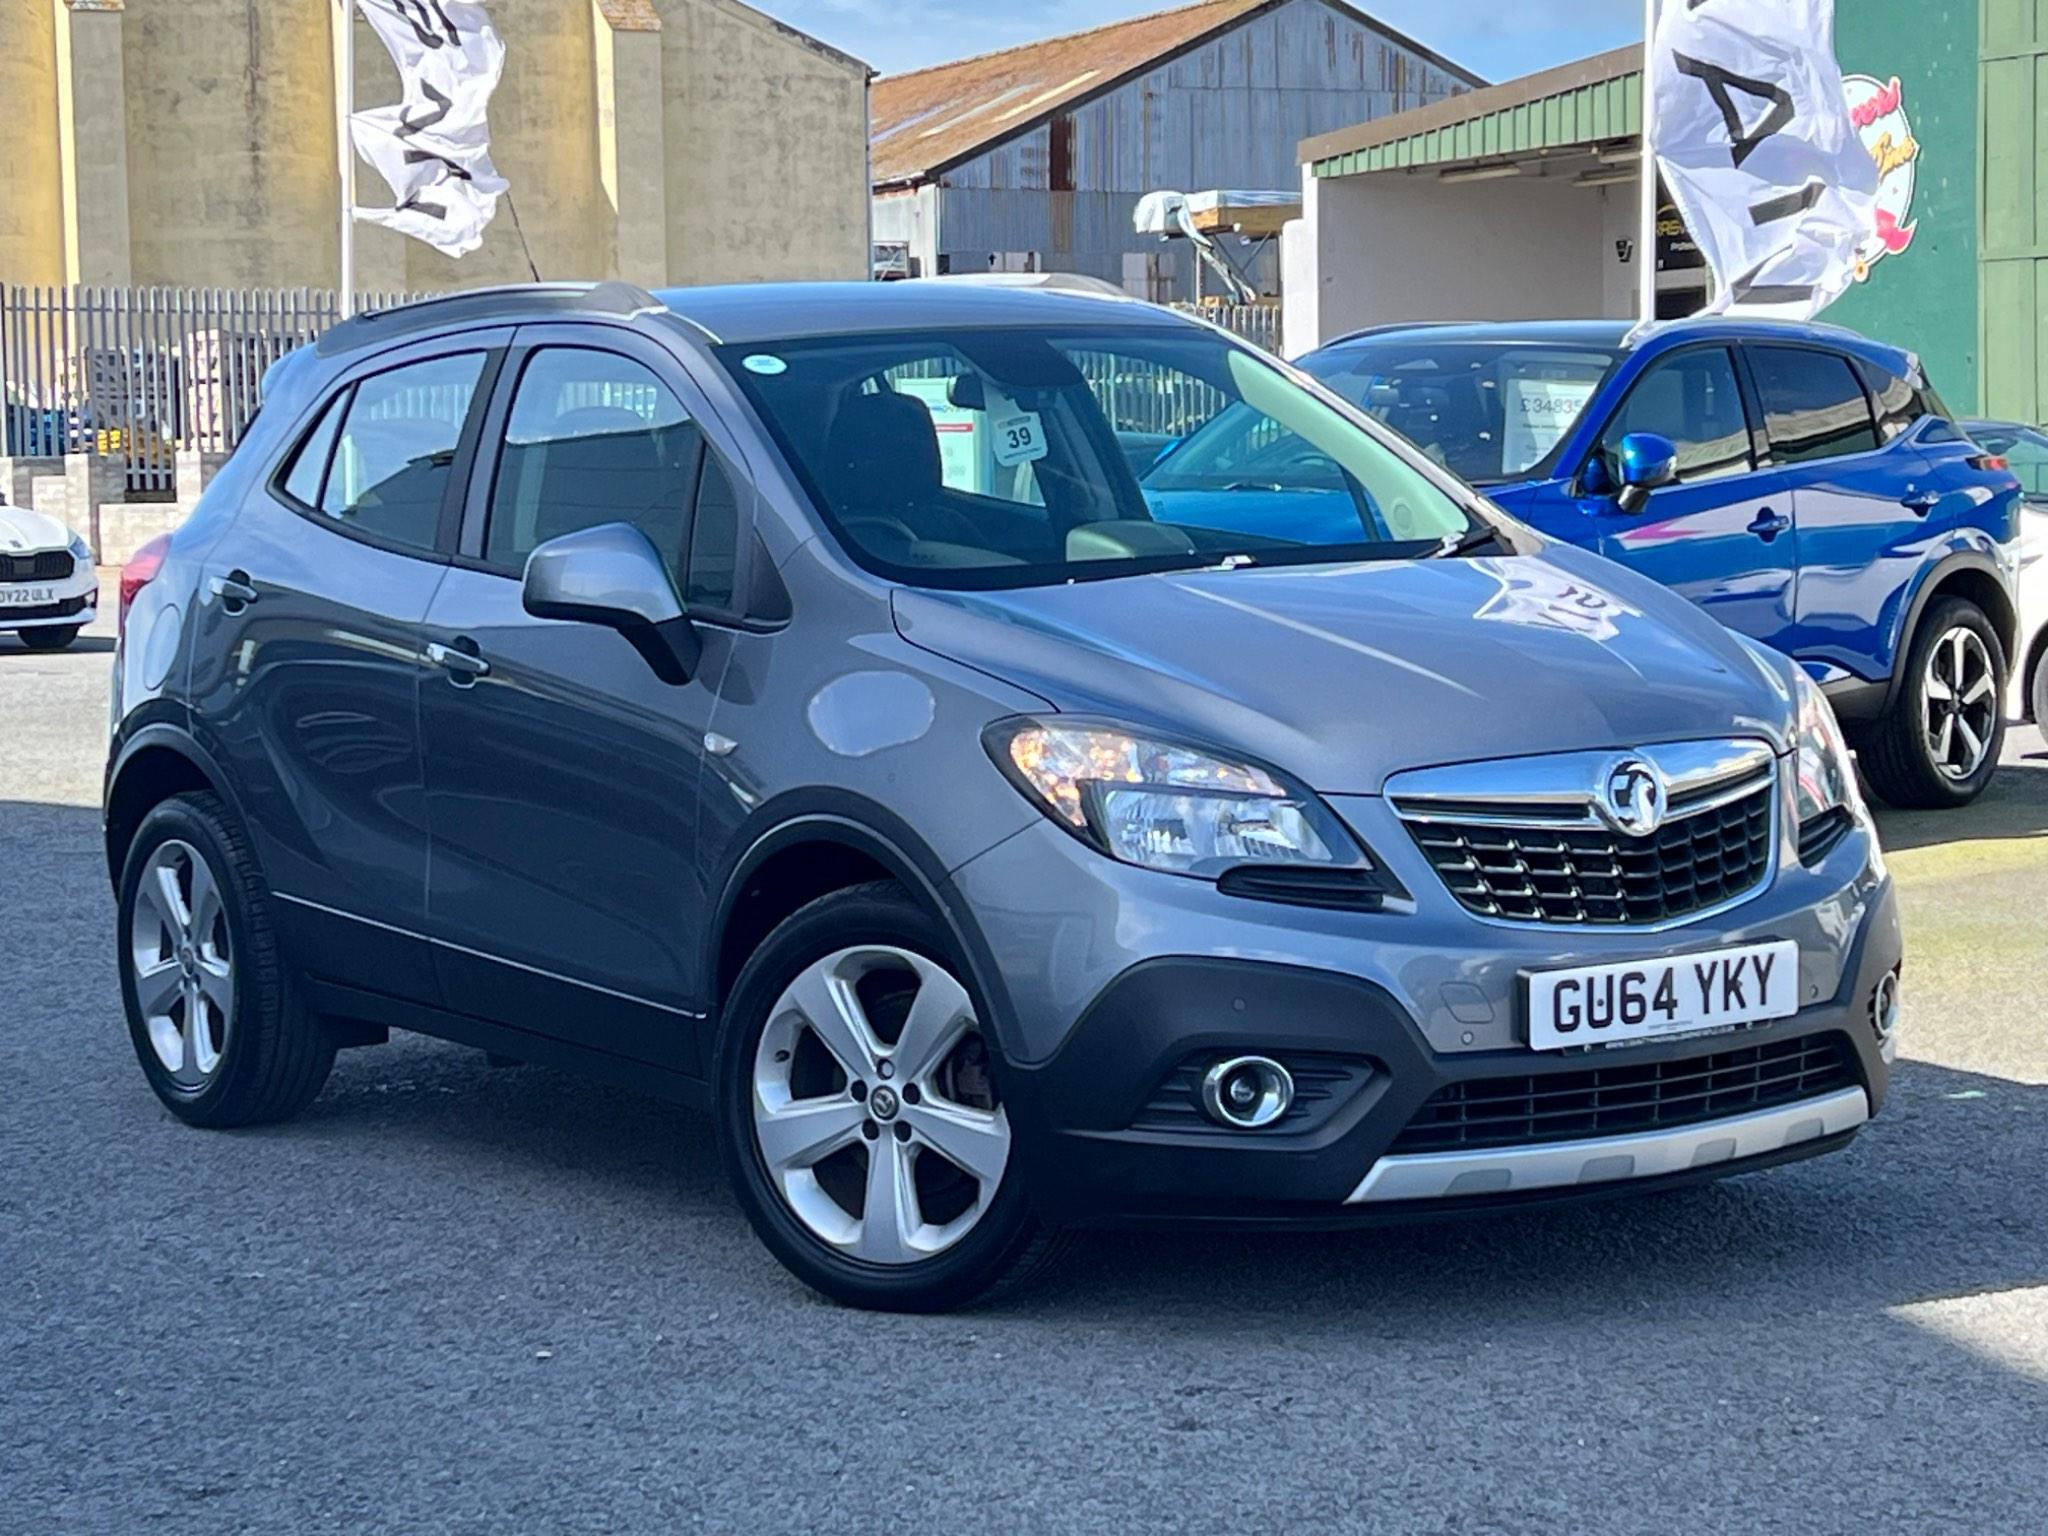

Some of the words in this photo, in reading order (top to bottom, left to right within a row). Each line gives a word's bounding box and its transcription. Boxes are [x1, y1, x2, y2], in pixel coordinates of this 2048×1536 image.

[1007, 426, 1032, 449] 39
[1553, 966, 1679, 1034] GU64
[1694, 952, 1776, 1015] YKY
